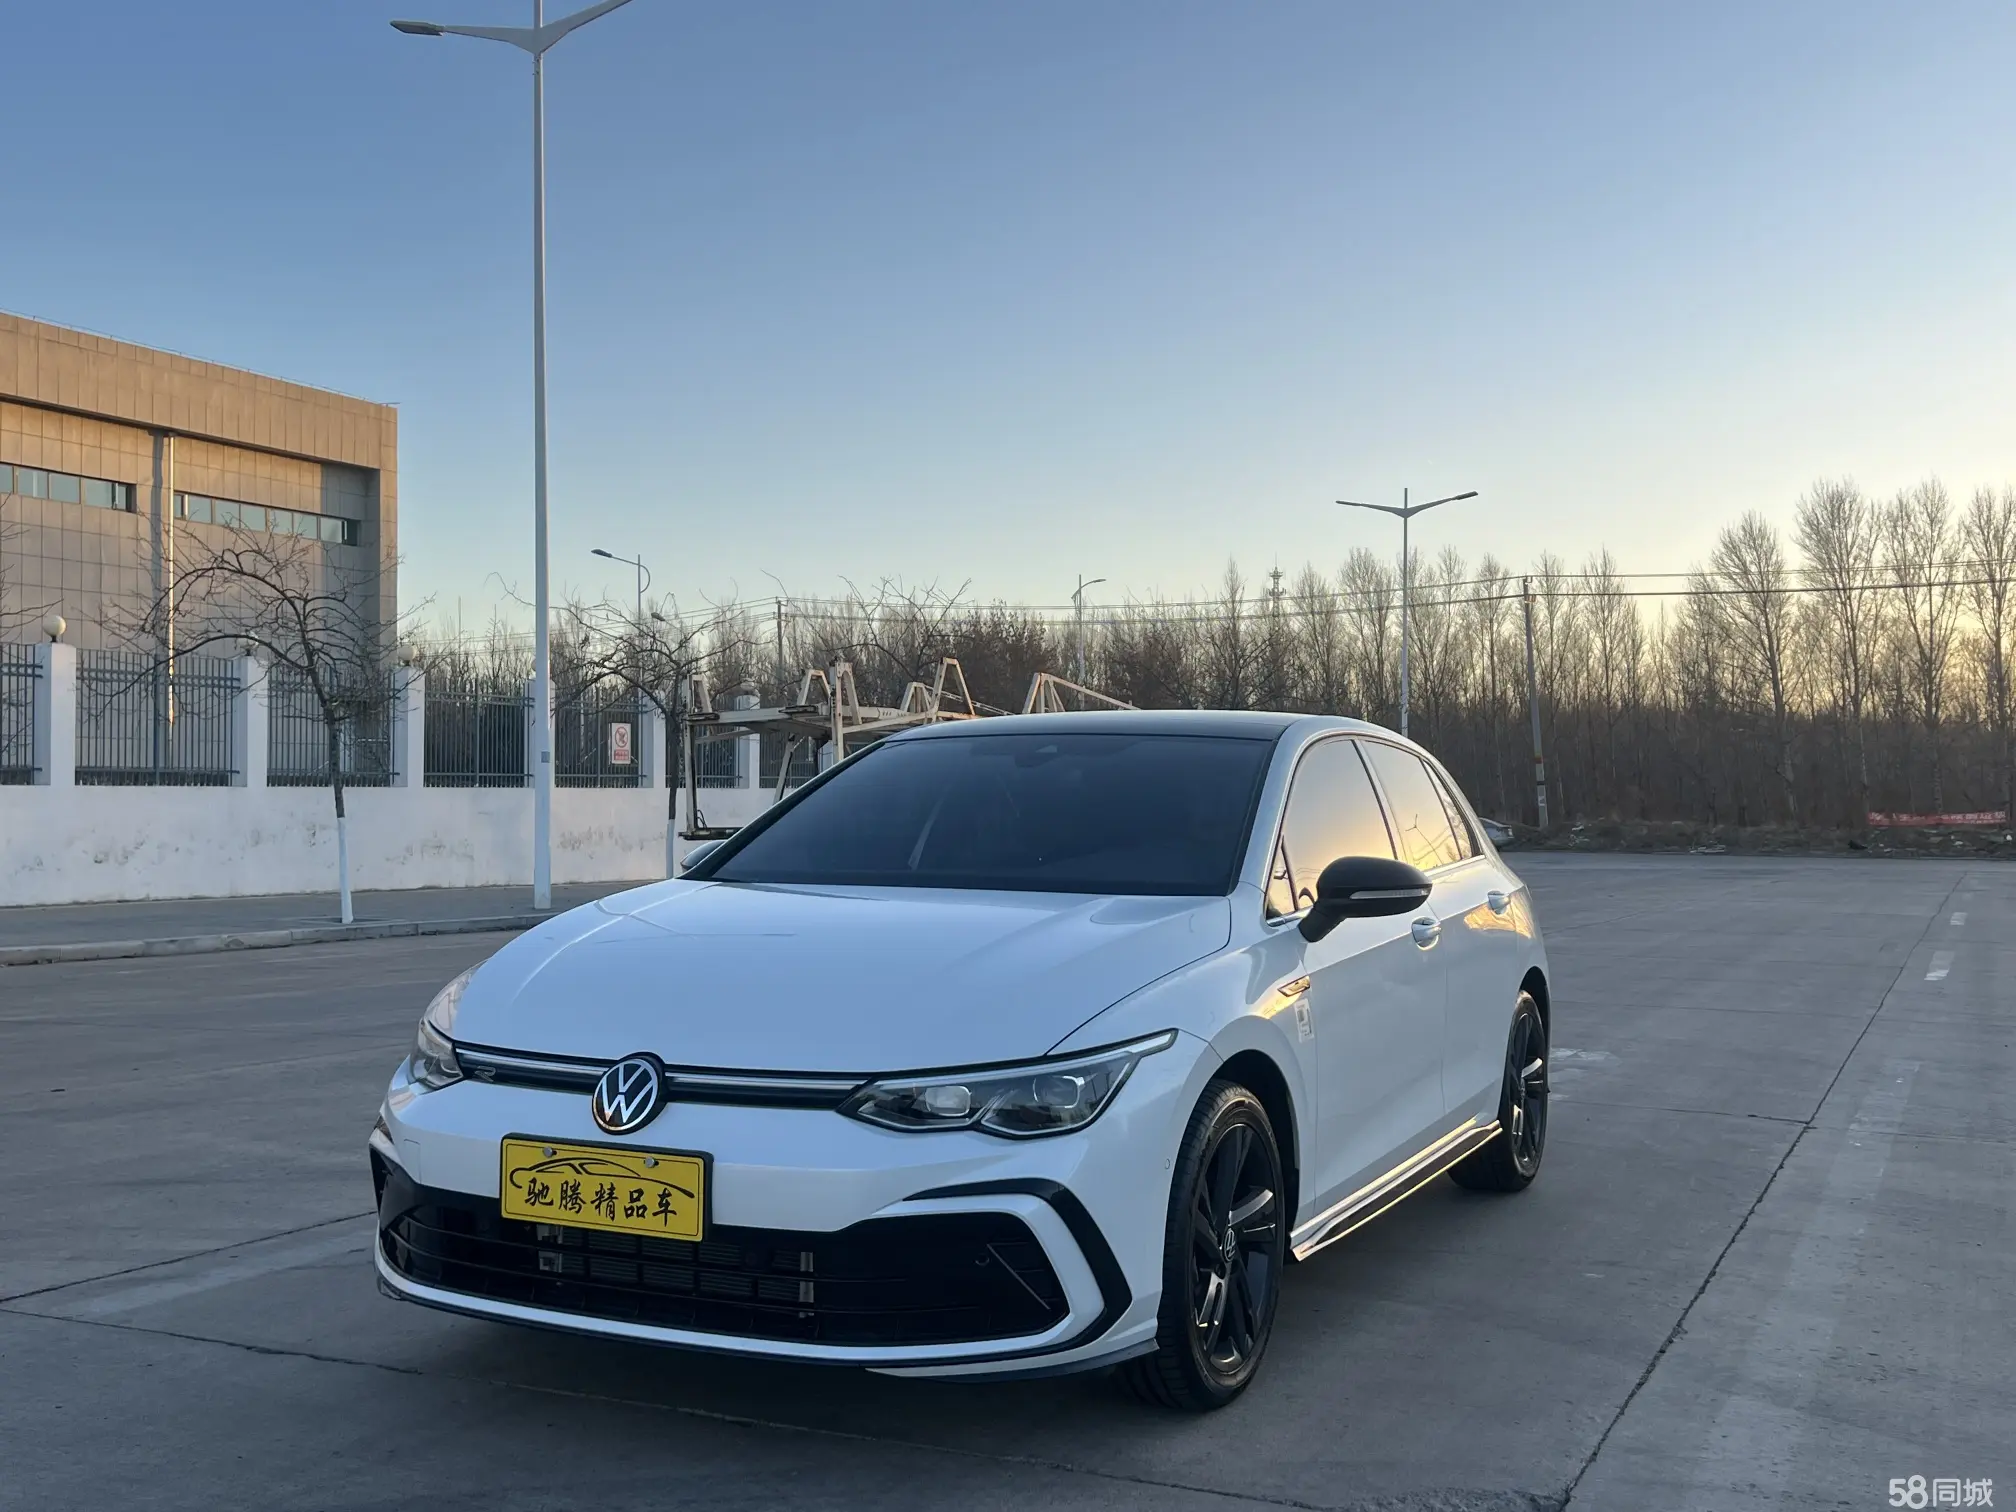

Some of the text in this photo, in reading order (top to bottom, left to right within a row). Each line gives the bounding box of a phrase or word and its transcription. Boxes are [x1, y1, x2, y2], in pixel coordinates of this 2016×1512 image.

[524, 1177, 677, 1227] 驰腾精品车
